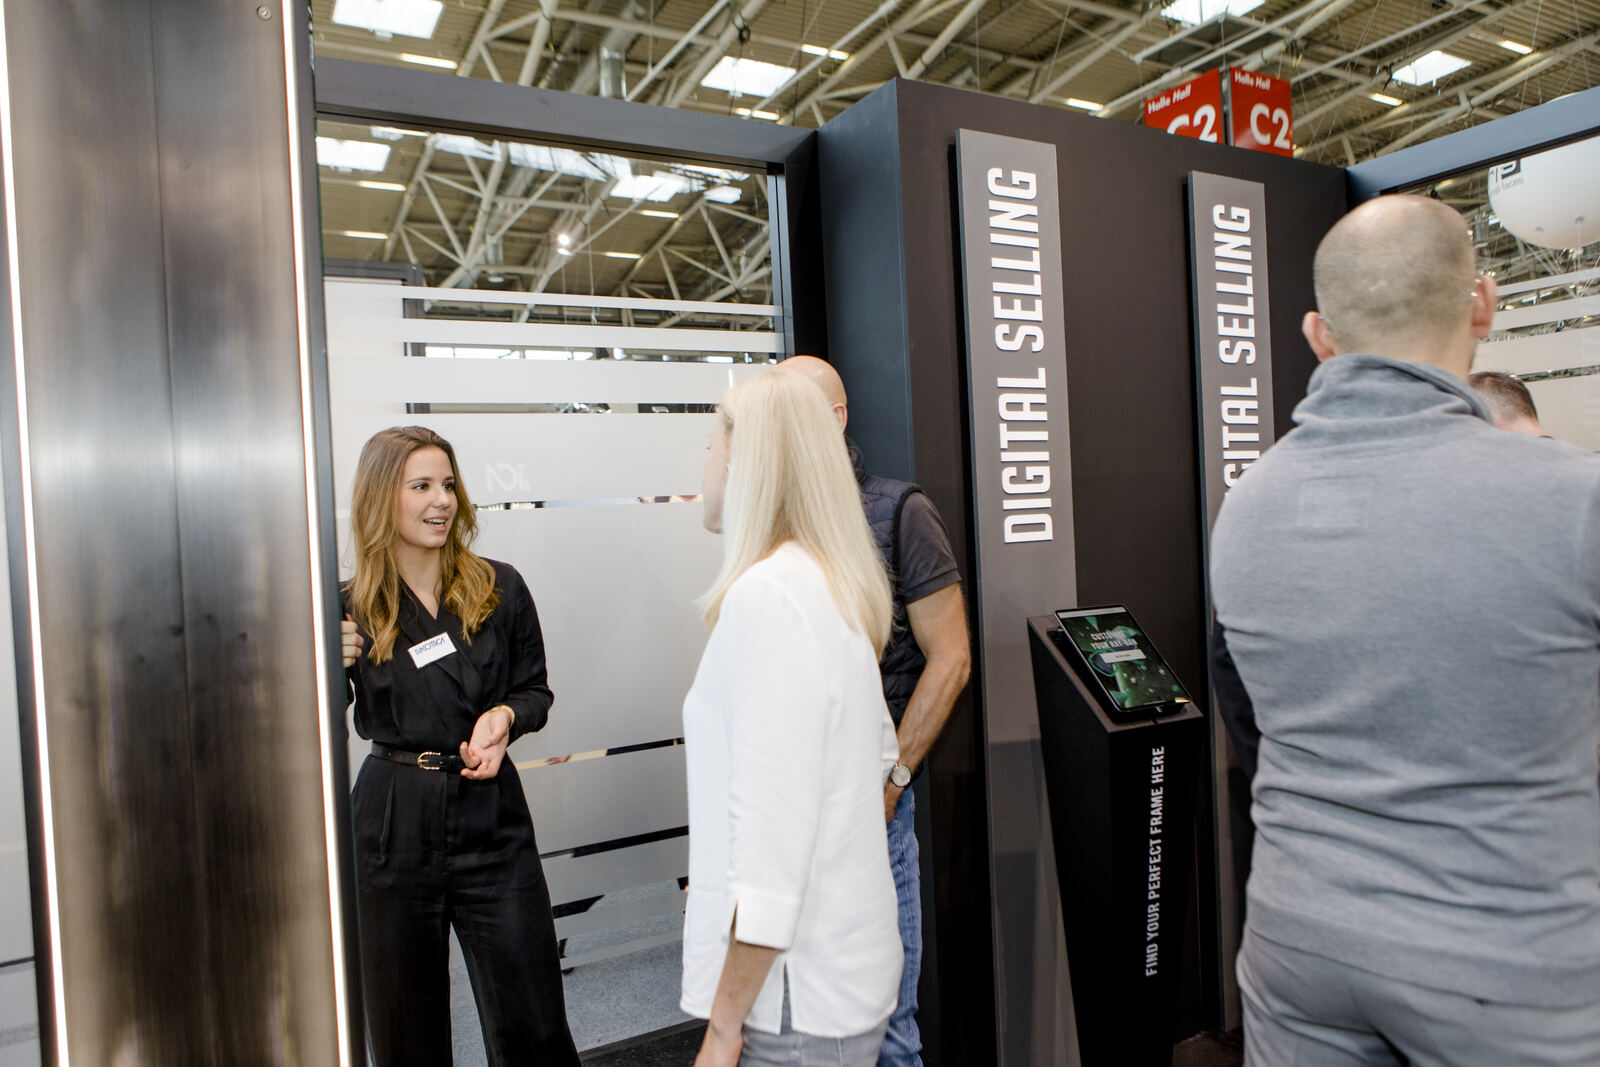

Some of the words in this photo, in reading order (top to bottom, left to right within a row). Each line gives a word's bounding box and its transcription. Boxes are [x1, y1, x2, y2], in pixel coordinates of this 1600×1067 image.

[1148, 96, 1171, 114] Halle
[1173, 84, 1191, 103] Hall
[1234, 71, 1254, 87] Halle
[1256, 76, 1271, 91] Hall
[1250, 103, 1290, 150] C2
[987, 167, 1045, 352] SELLING
[1212, 204, 1256, 365] SELLING
[996, 367, 1053, 544] DIGITAL
[1220, 377, 1260, 489] ITAL
[1151, 745, 1165, 784] HERE
[1150, 786, 1163, 835] FRAME
[1148, 838, 1162, 901] PERFECT
[1146, 902, 1160, 942] YOUR
[1145, 943, 1158, 977] FIND
